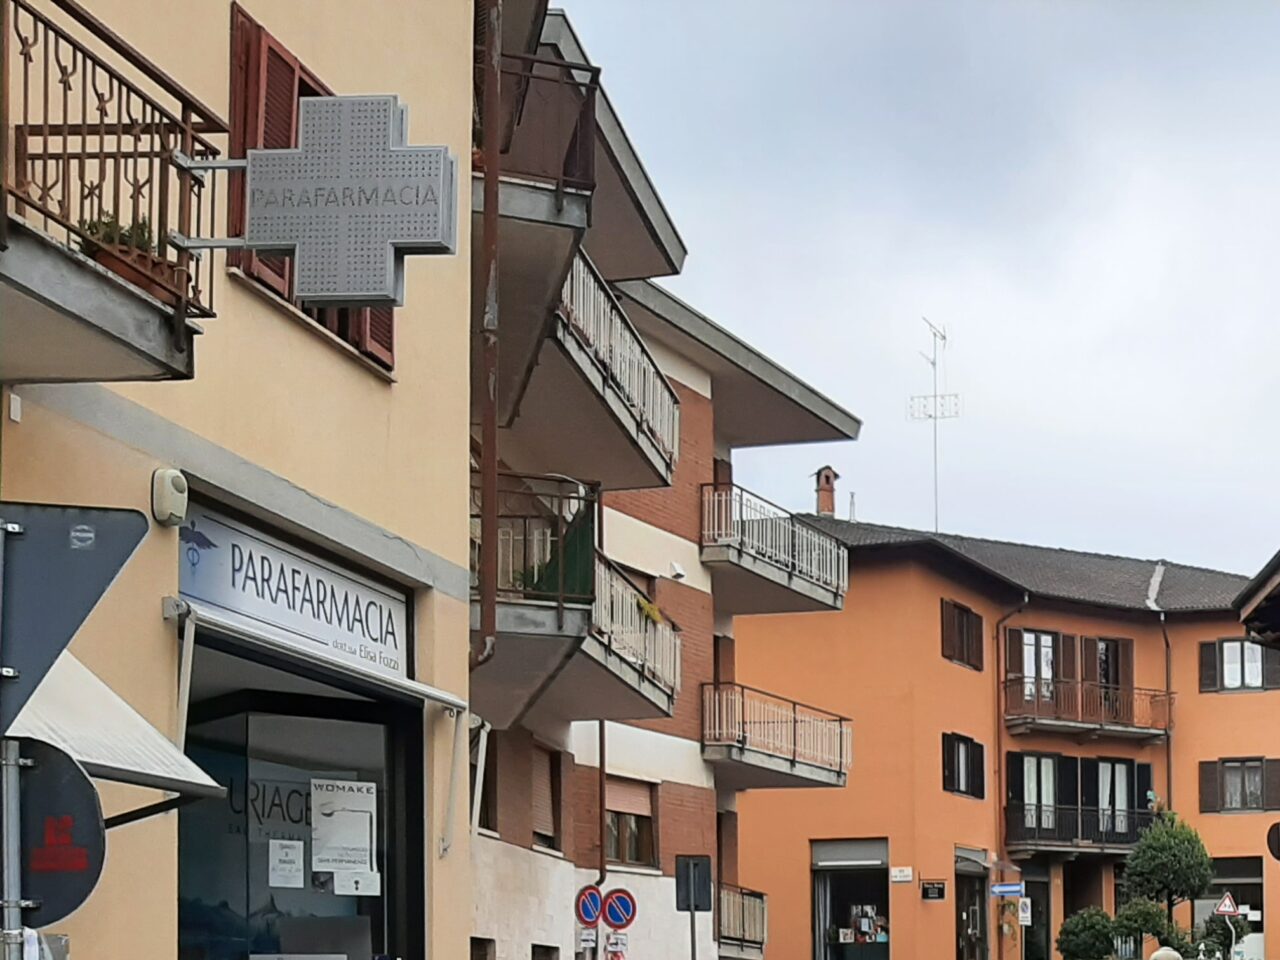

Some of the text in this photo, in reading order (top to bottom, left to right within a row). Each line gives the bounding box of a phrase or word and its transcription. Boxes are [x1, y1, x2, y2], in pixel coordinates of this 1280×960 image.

[251, 185, 438, 208] PARAFARMACIA
[231, 543, 398, 650] PARAFARMACIA
[314, 783, 374, 795] WOMAKE
